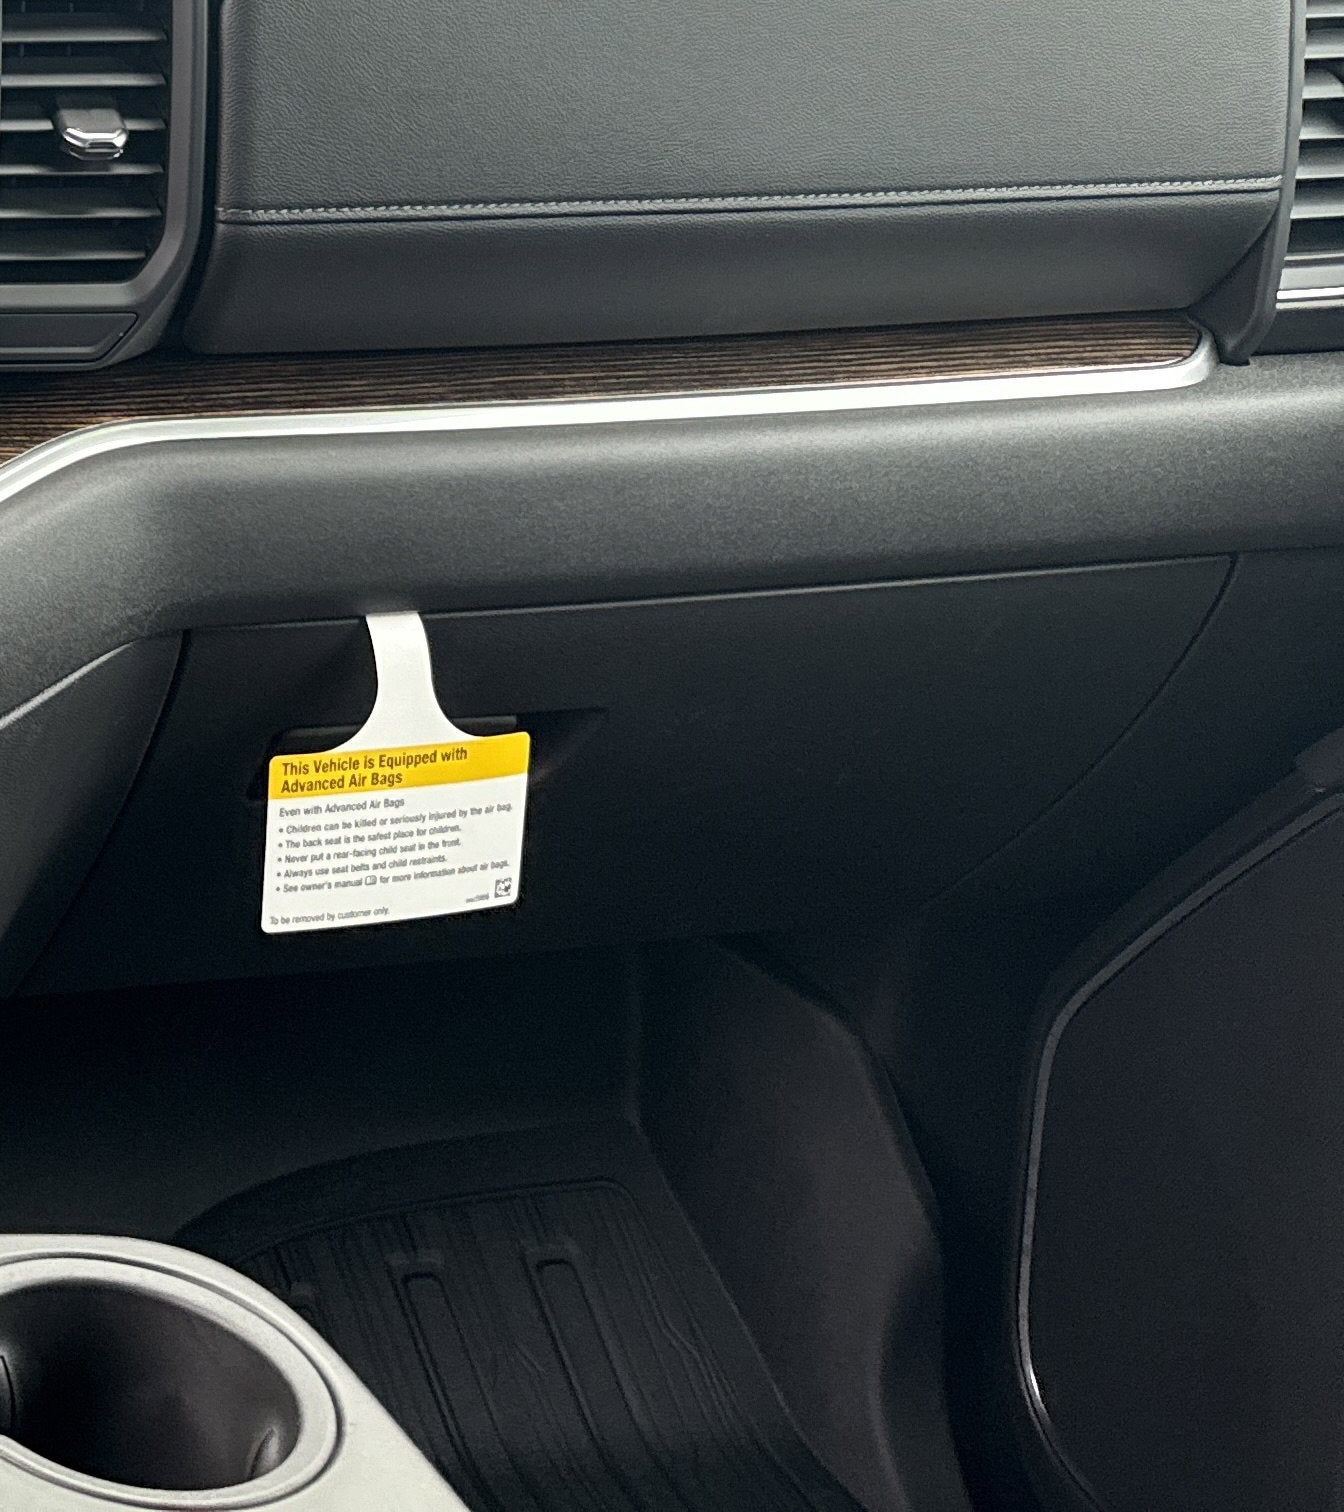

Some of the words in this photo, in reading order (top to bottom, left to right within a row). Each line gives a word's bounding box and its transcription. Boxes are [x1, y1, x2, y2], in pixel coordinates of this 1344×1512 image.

[282, 762, 309, 776] This
[313, 757, 360, 774] Vehicle
[363, 756, 375, 770] is
[378, 749, 437, 769] Equipped
[440, 747, 468, 762] with
[280, 775, 344, 794] Advanced
[348, 773, 368, 787] Air
[371, 771, 403, 787] Bags
[279, 808, 301, 818] Even
[303, 805, 322, 815] with
[325, 800, 367, 813] Advanced
[369, 799, 381, 809] Air
[383, 798, 405, 809] Bags
[286, 823, 322, 834] Children
[324, 822, 339, 831] can
[342, 820, 352, 830] be
[354, 817, 377, 828] killed
[379, 818, 387, 826] or
[390, 813, 427, 824] seriously
[458, 809, 468, 818] by
[470, 807, 482, 816] the
[285, 839, 301, 849] The
[302, 837, 322, 848] back
[324, 835, 342, 846] seat
[353, 834, 365, 843] the
[367, 831, 391, 841] safest
[284, 868, 313, 878] Always
[283, 884, 298, 893] See
